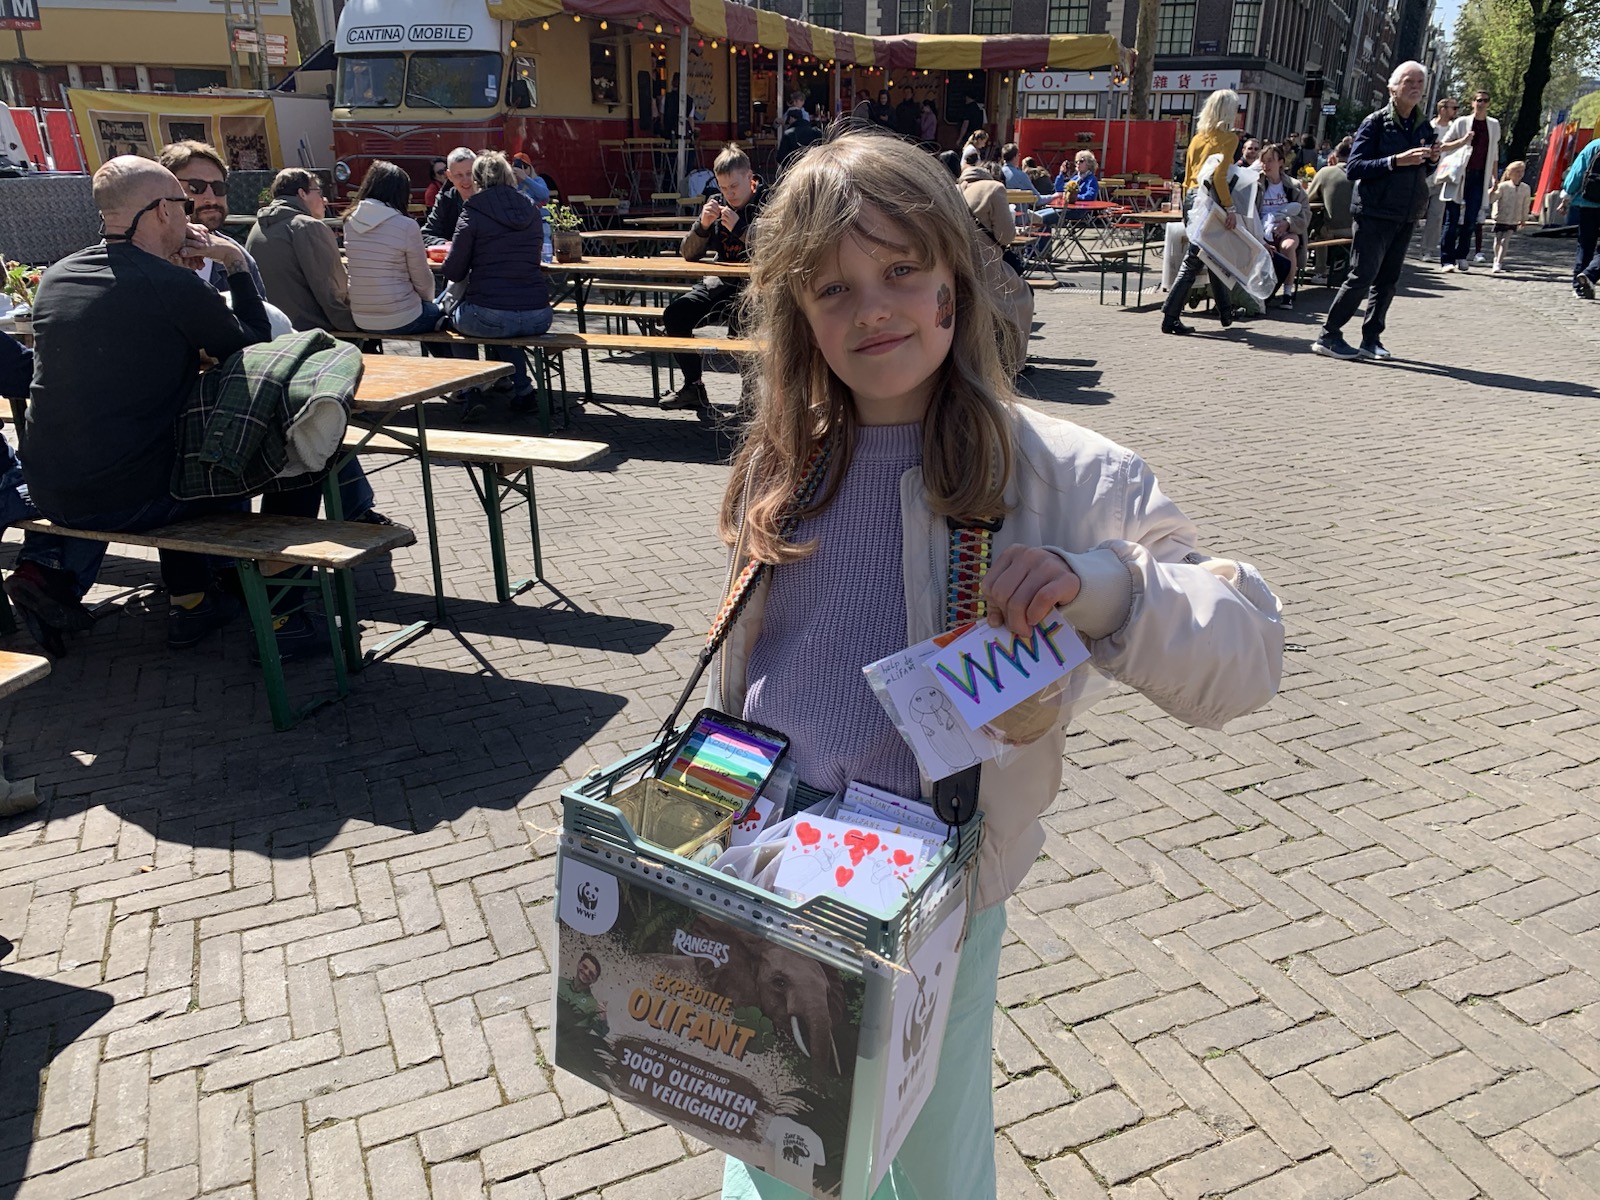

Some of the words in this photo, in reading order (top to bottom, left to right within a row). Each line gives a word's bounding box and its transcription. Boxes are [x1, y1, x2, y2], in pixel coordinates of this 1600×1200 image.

[349, 28, 401, 41] CANTINA
[412, 27, 467, 40] MOBILE
[936, 608, 1064, 704] WWF
[576, 907, 597, 921] WWF
[672, 928, 730, 968] RANGERS
[652, 972, 733, 1017] EXPEDITIE
[627, 986, 757, 1061] OLIFANT
[621, 1048, 665, 1079] 3000
[669, 1069, 758, 1116] OLIFANTEN
[643, 1046, 658, 1056] HELP
[658, 1053, 668, 1061] JIJ
[669, 1056, 681, 1067] MIJ
[681, 1061, 690, 1070] IN
[689, 1065, 705, 1077] DEZE
[705, 1071, 731, 1086] STRIJD?
[629, 1073, 648, 1092] IN
[651, 1082, 748, 1133] VEILIGHEID!
